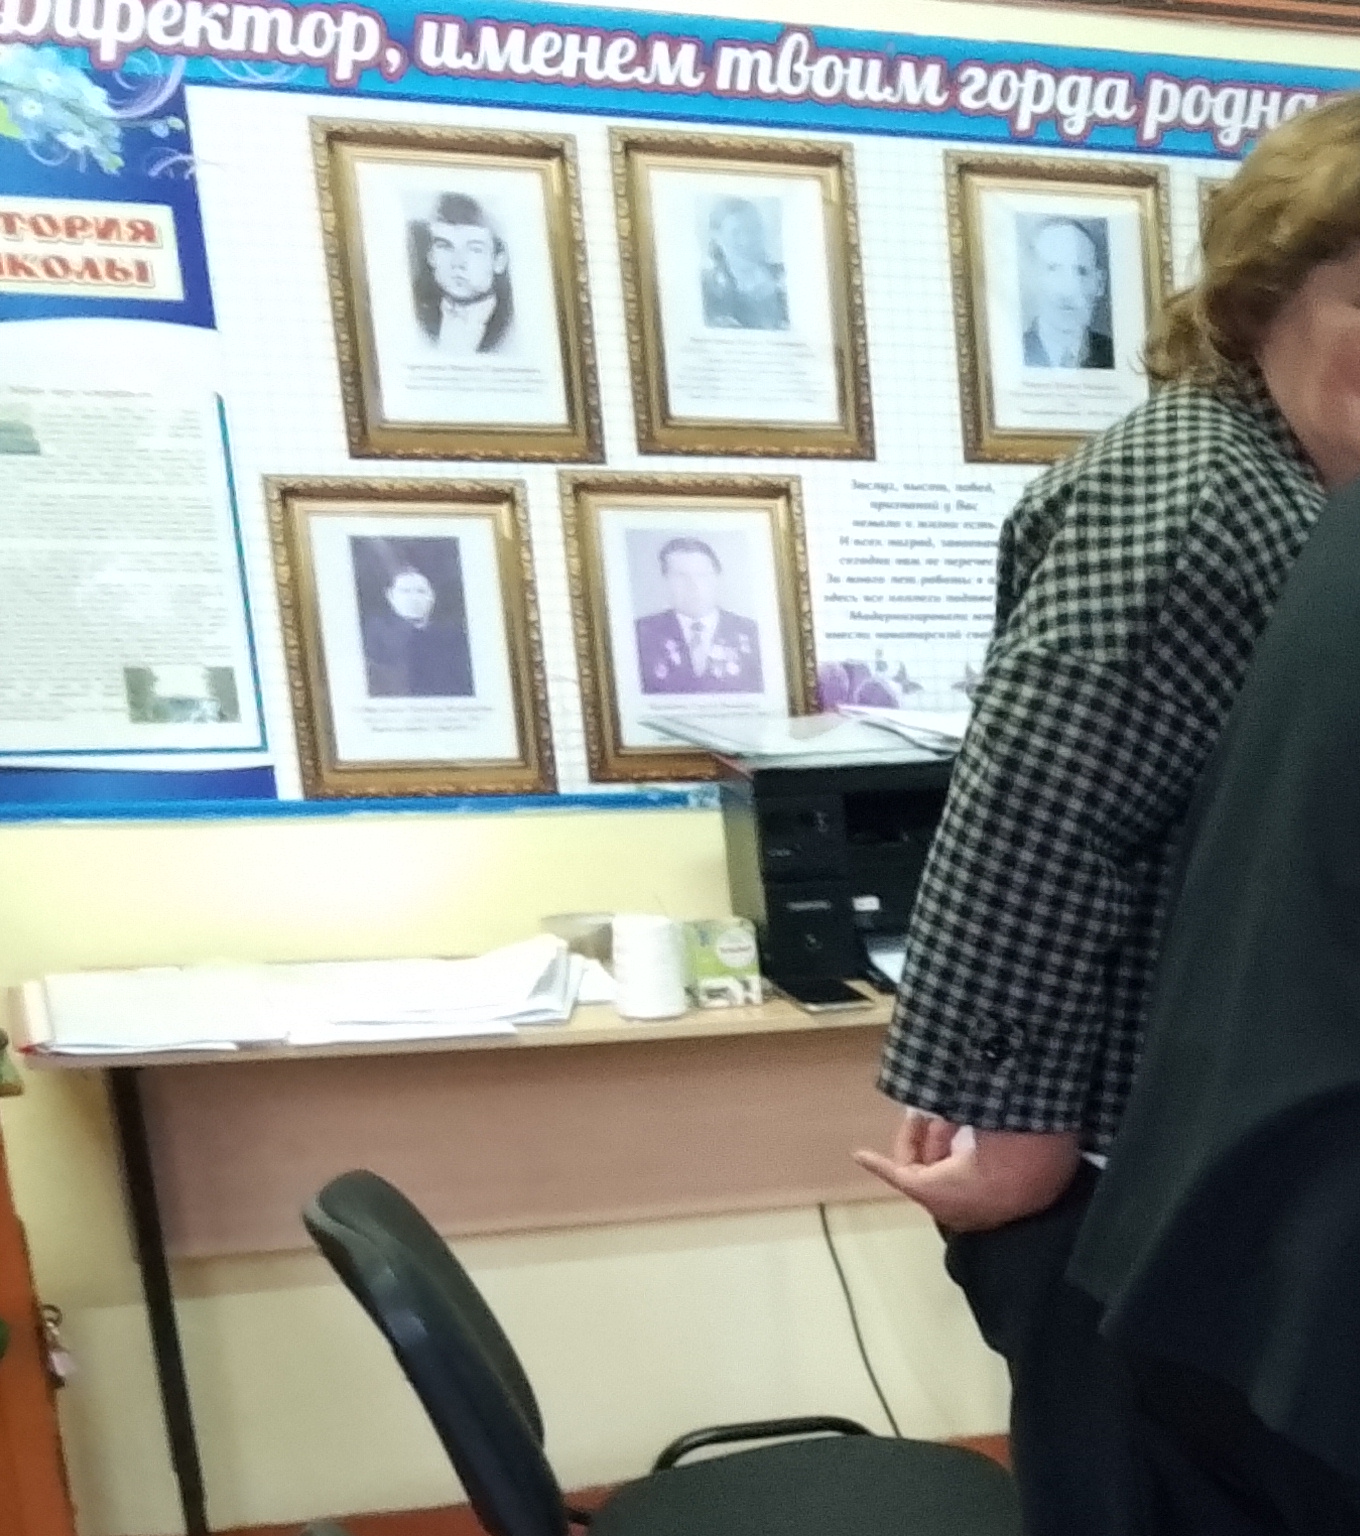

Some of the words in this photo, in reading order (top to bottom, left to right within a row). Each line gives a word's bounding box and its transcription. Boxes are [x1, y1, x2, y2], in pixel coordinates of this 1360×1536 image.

[418, 20, 706, 89] именем
[715, 31, 949, 108] твоим
[959, 62, 1137, 136] горда
[0, 251, 152, 285] КОЛЫ
